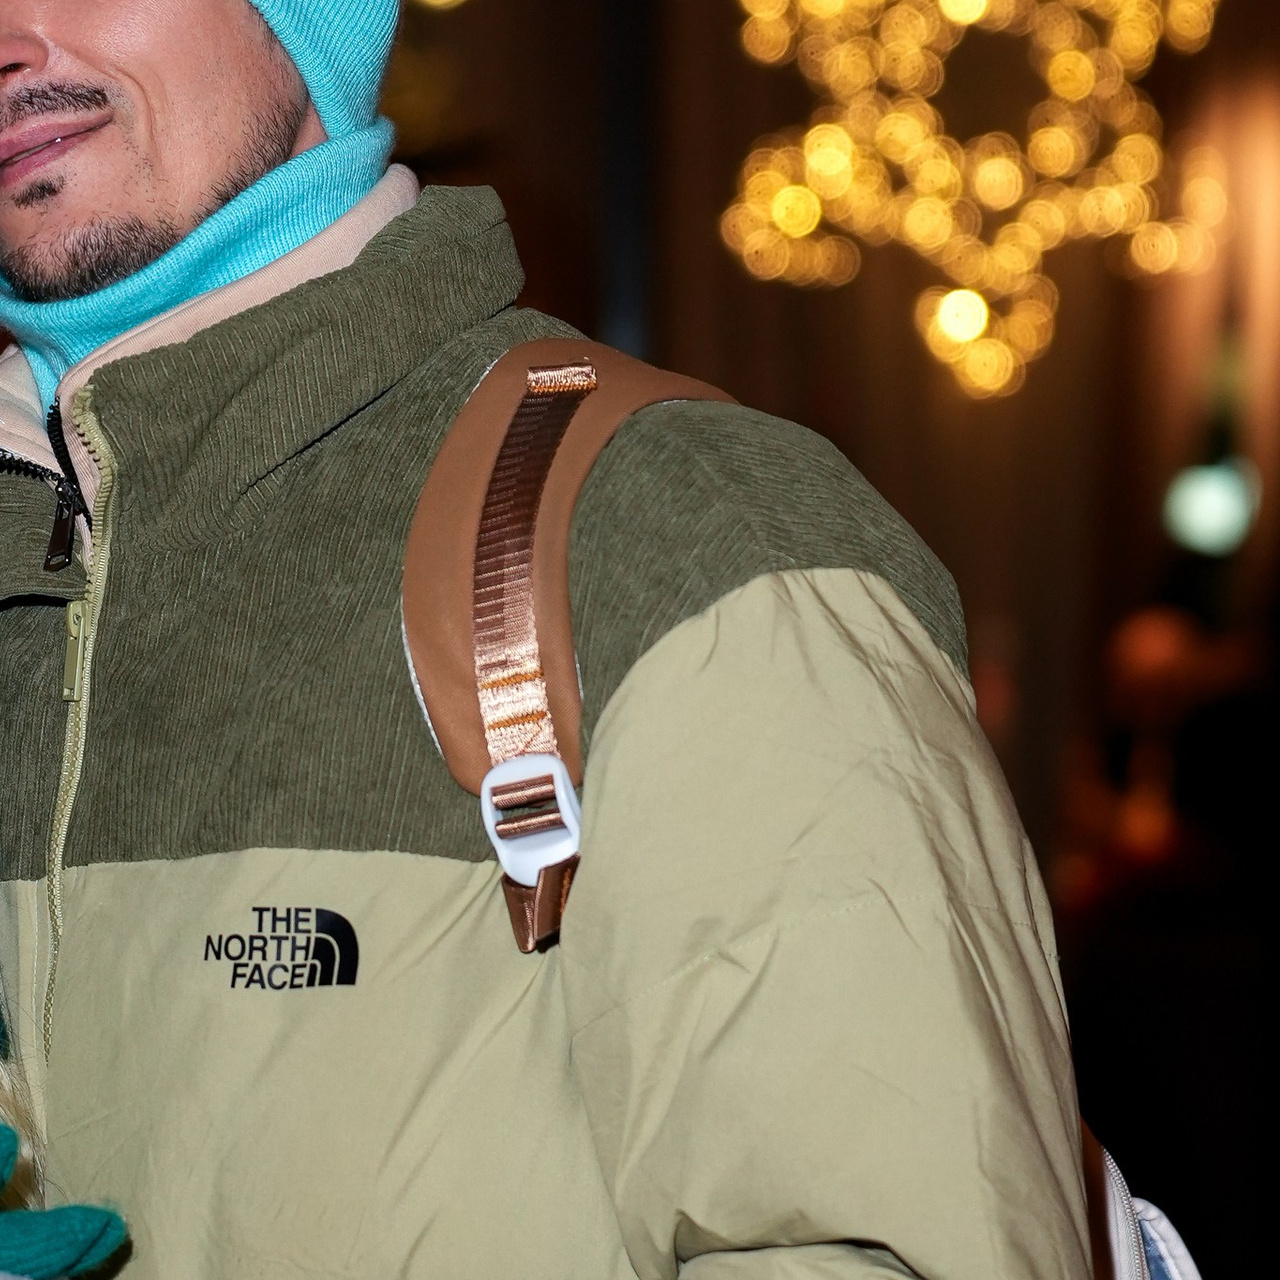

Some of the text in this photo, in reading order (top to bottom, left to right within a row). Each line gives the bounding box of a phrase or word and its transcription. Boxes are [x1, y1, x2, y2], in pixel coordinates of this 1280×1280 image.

[252, 907, 312, 934] THE
[204, 934, 311, 962] NORTH
[230, 962, 308, 990] FACE
